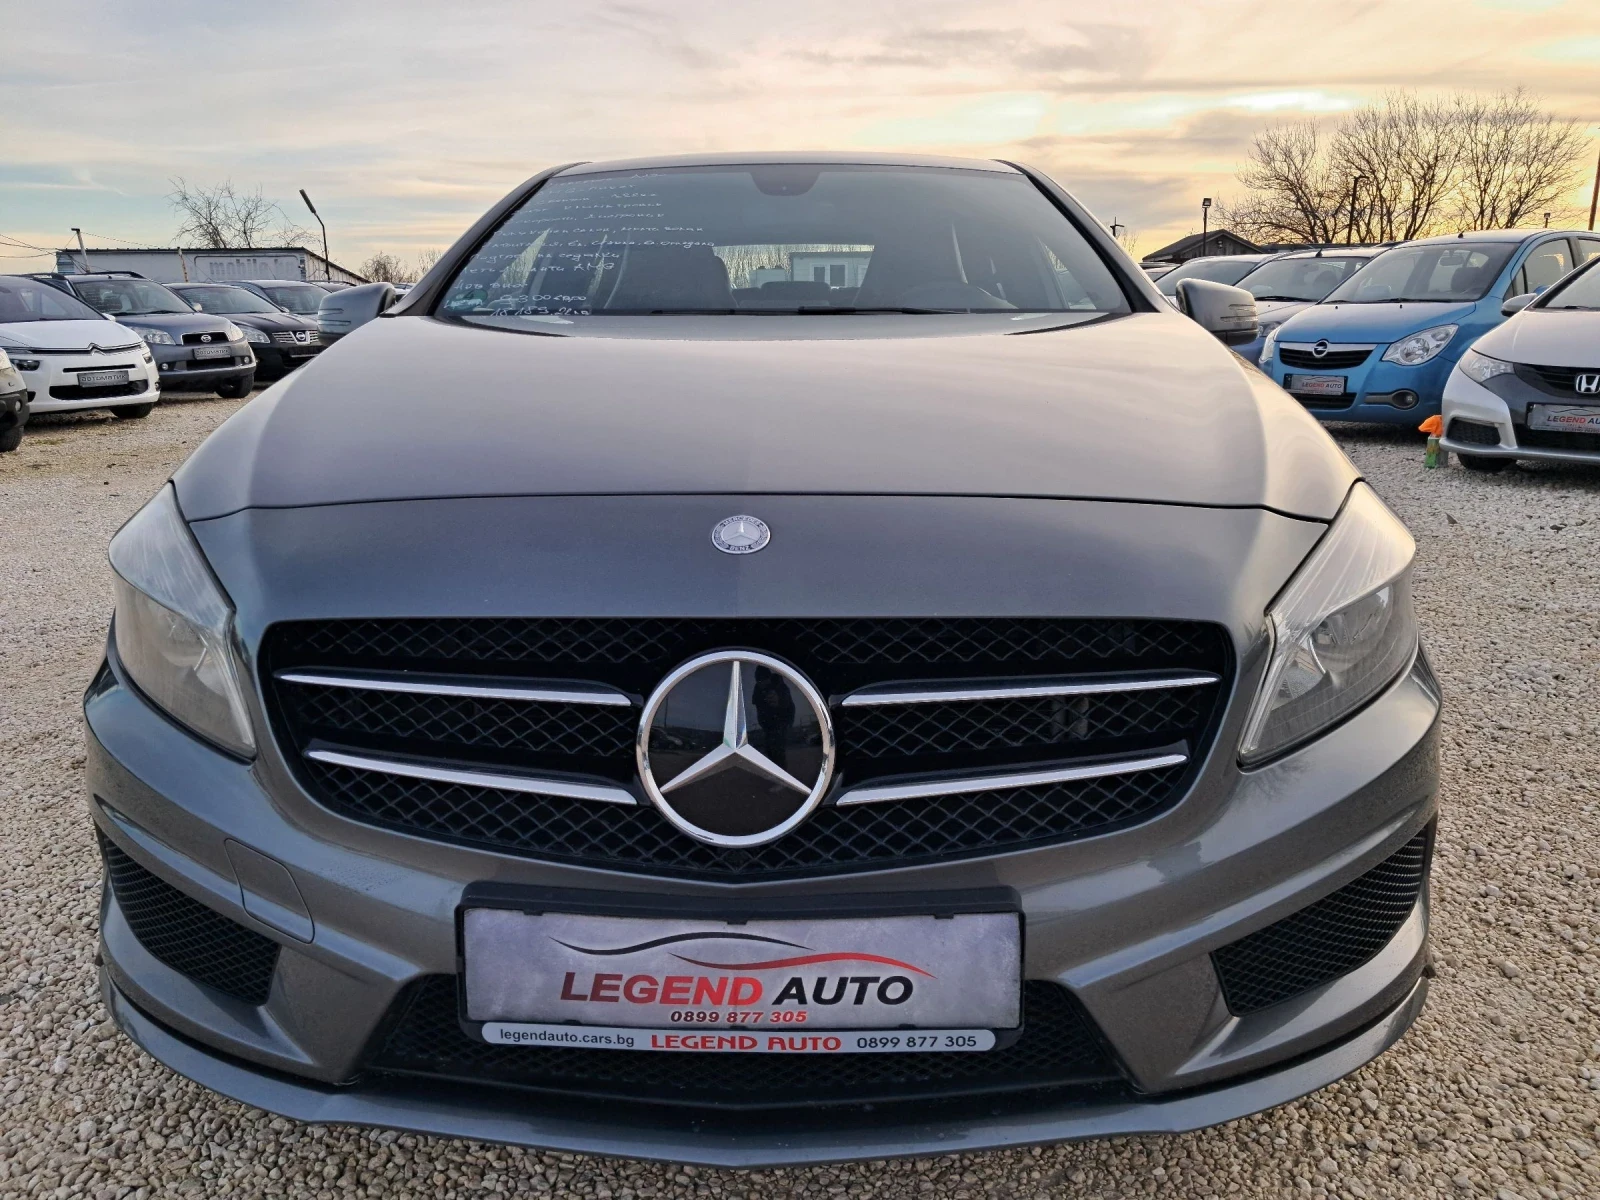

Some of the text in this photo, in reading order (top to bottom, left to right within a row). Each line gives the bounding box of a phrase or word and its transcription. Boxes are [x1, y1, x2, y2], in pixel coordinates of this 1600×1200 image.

[81, 373, 127, 384] автоматик
[1547, 416, 1586, 425] LEGEND
[560, 971, 914, 1006] LEGEND AUTO
[669, 1010, 807, 1024] 0899 877 305
[500, 1028, 977, 1051] legendauto.cars.bg LEGEND AUTO 0899 877 305
